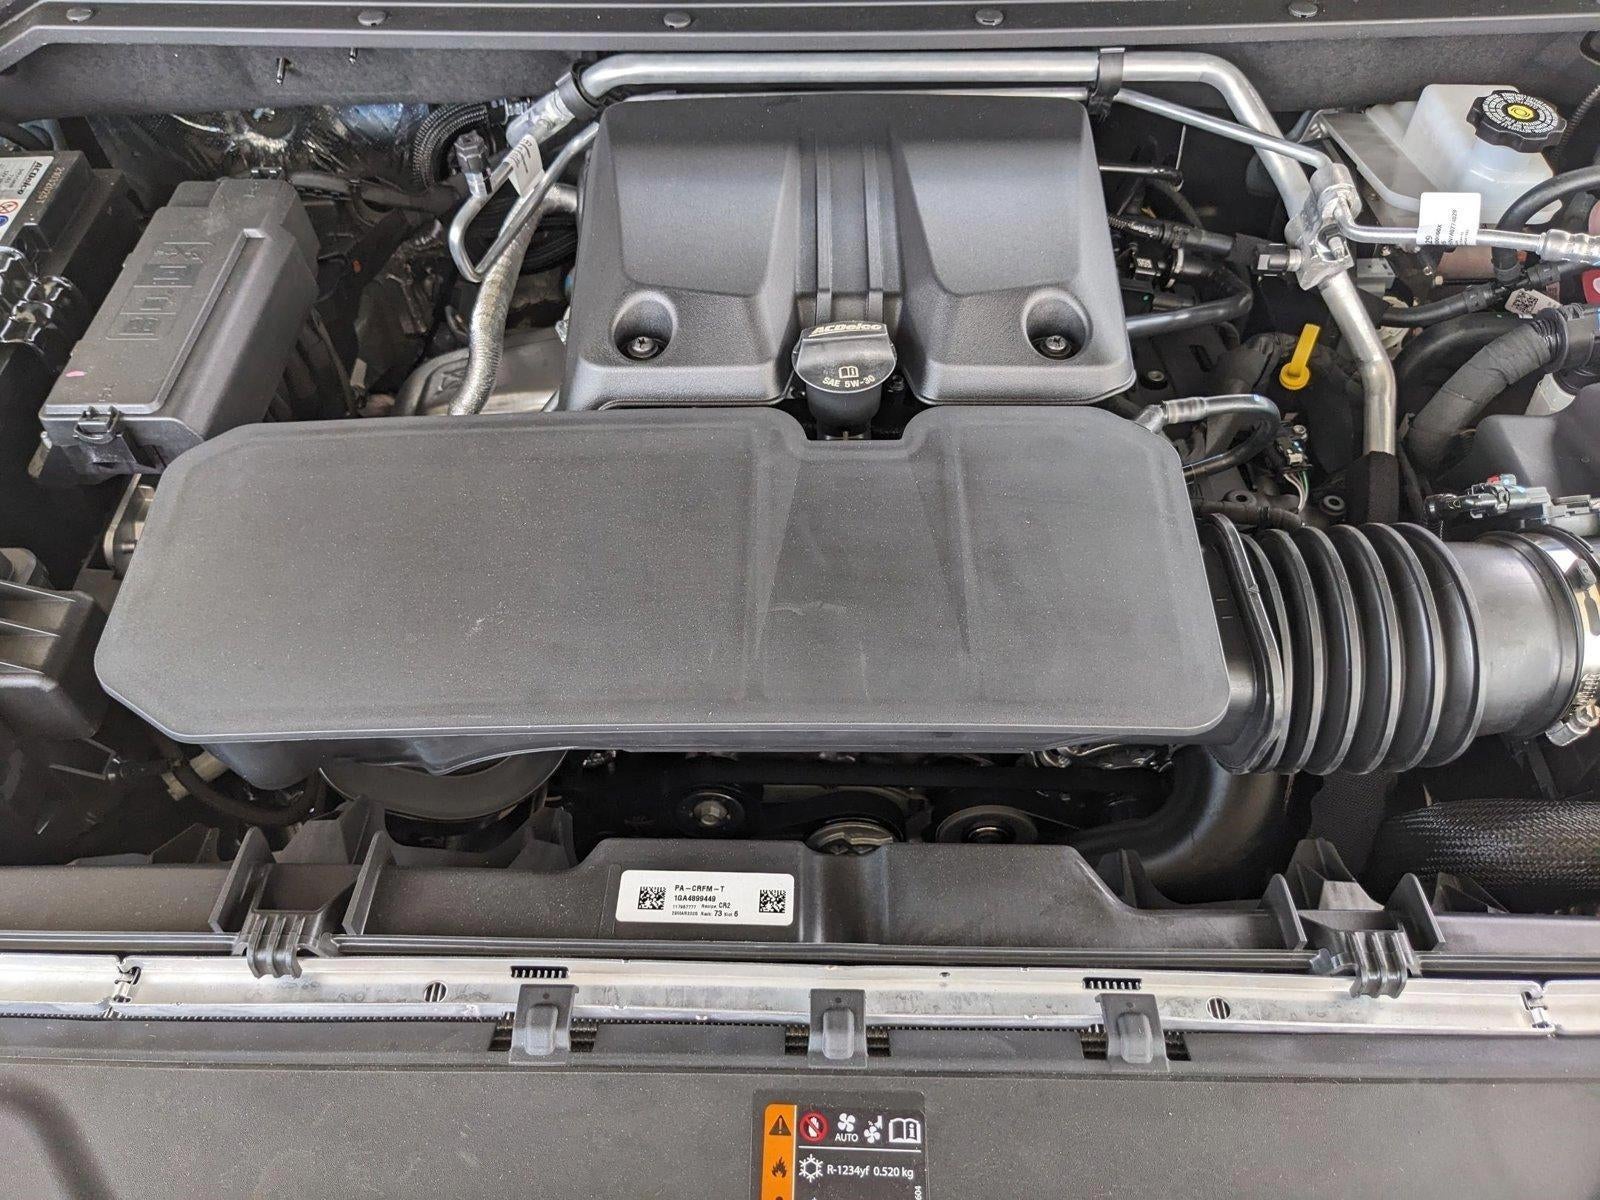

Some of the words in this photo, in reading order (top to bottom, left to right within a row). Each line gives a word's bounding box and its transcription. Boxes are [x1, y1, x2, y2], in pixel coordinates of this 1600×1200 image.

[808, 323, 882, 337] ACDelco
[822, 376, 841, 388] SAE
[844, 375, 876, 388] 5W-30
[714, 909, 723, 917] 73
[834, 1132, 859, 1142] AUTO
[826, 1165, 871, 1176] R-1234yf
[873, 1166, 900, 1177] 0.520
[901, 1166, 914, 1180] kg
